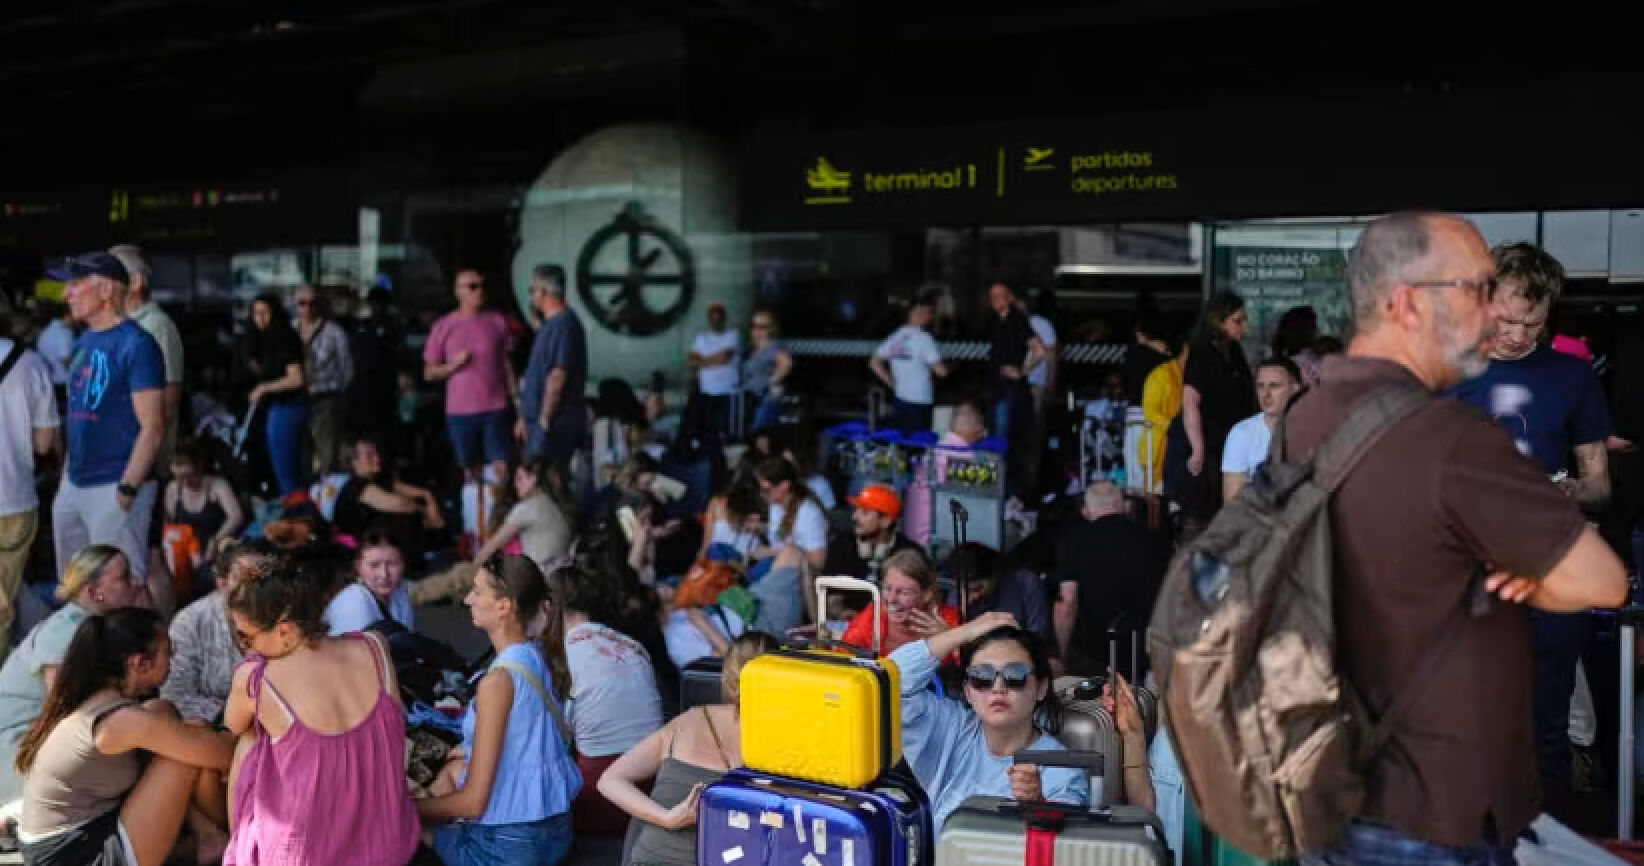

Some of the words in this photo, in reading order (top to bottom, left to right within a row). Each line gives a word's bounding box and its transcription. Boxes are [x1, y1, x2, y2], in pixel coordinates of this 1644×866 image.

[1071, 151, 1152, 170] partidas
[864, 166, 961, 192] terminal
[1071, 173, 1177, 193] departures
